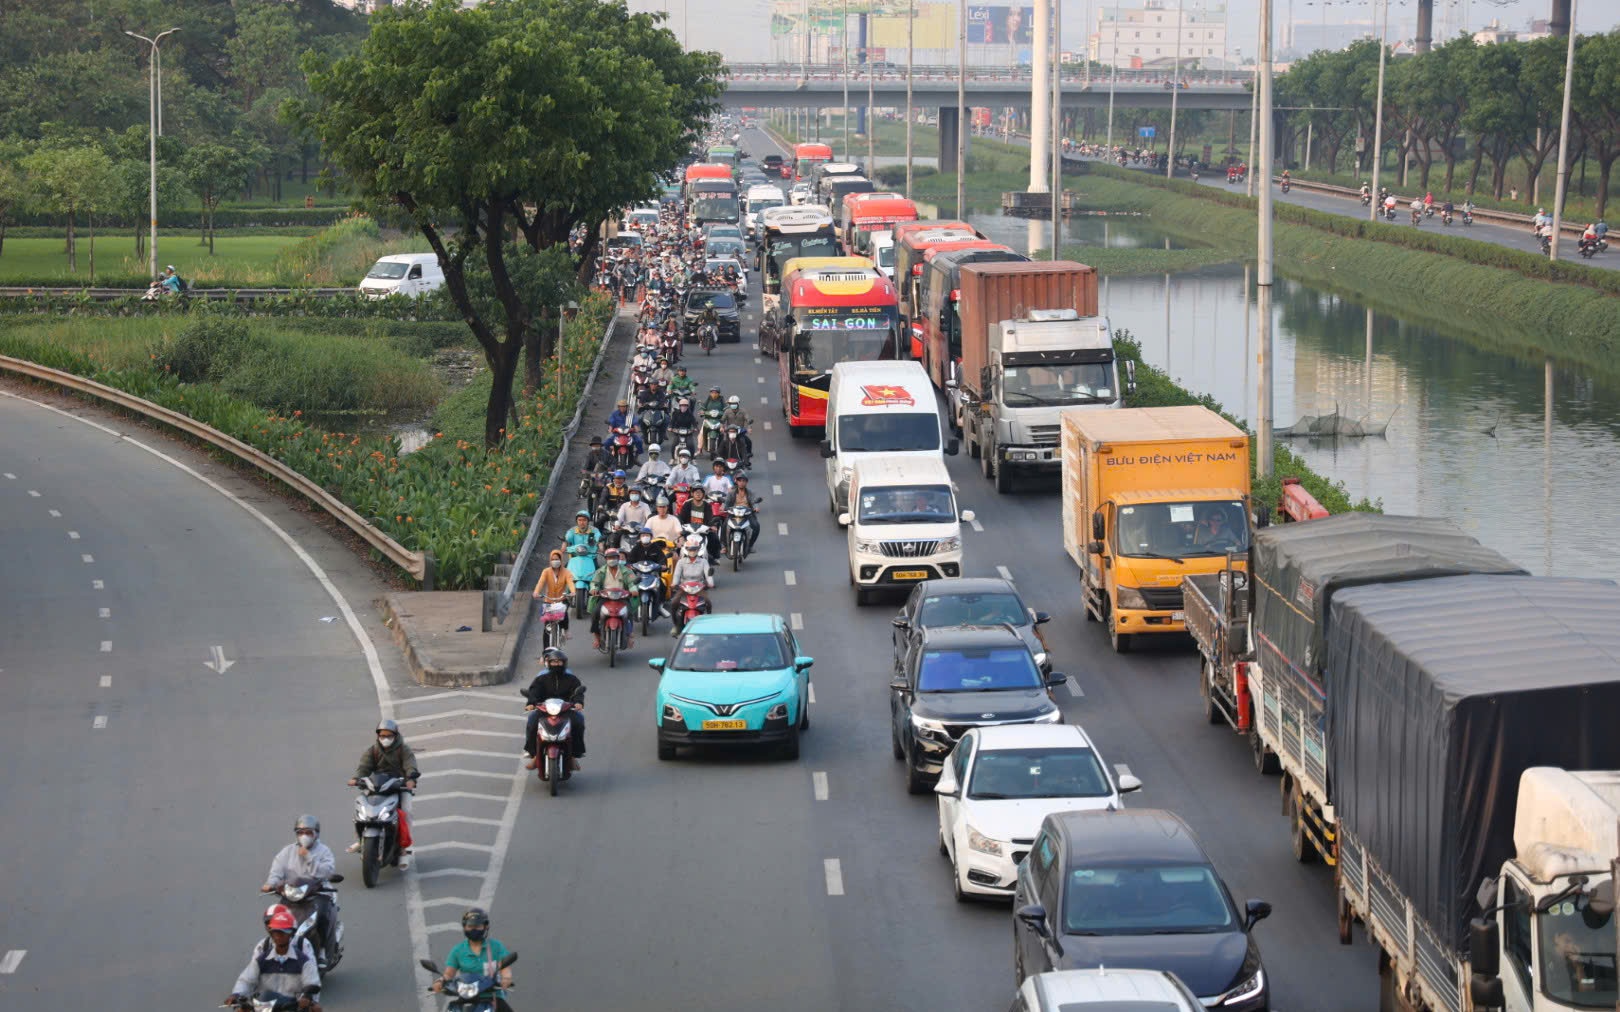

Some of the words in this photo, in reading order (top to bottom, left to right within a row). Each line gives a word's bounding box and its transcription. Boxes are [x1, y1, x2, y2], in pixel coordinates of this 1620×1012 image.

[812, 318, 838, 329] SAI
[845, 318, 876, 329] GON
[1106, 456, 1135, 466] BƯU
[1139, 454, 1172, 465] ĐIỆN
[1175, 452, 1203, 465] VIỆT
[1206, 452, 1236, 462] NAM
